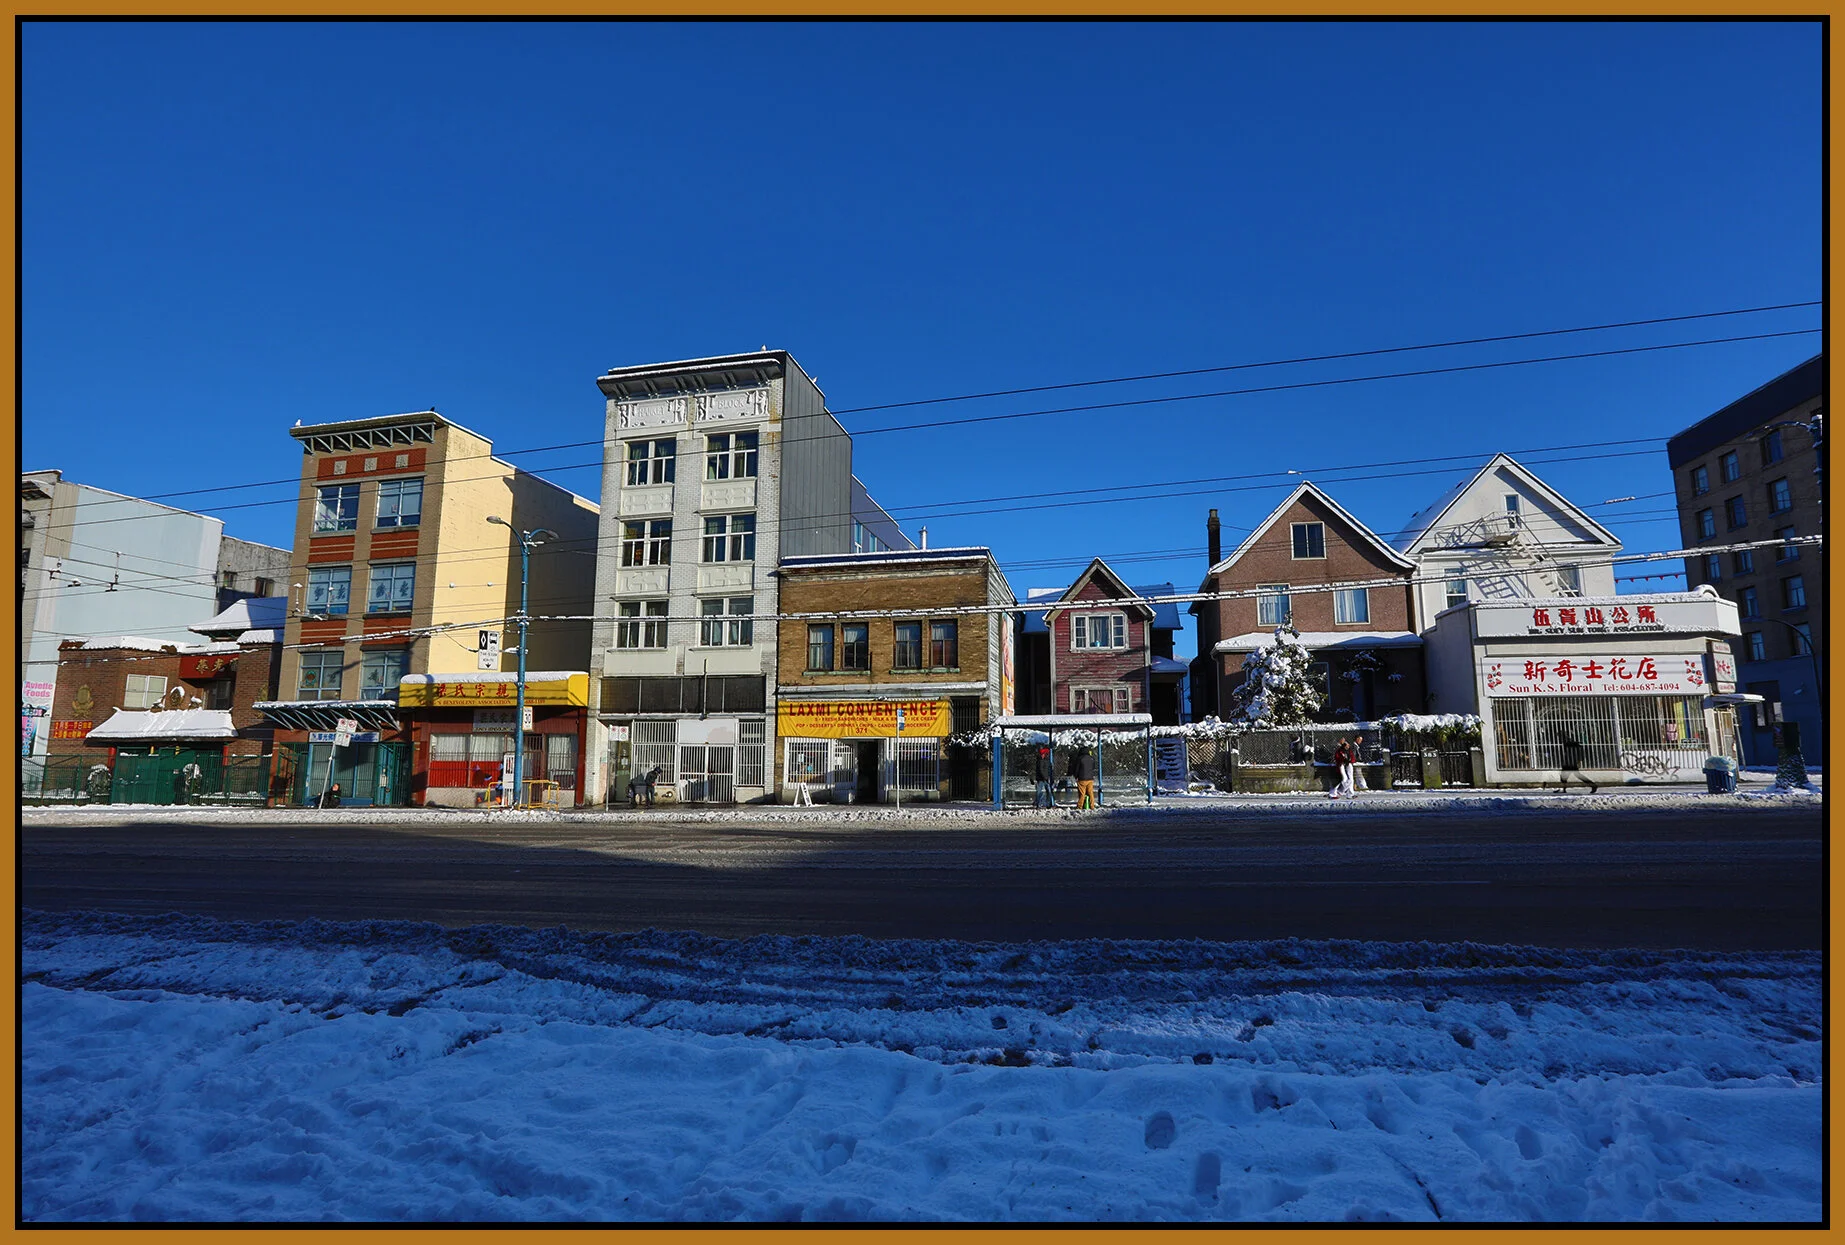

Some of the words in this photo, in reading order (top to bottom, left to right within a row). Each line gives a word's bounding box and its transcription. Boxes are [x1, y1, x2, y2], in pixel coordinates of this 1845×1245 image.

[1523, 656, 1658, 683] 新奇士花店
[1508, 683, 1530, 693] Sun
[1560, 682, 1593, 693] Floral
[789, 703, 830, 717] LAXMI
[837, 701, 937, 717] CONVENIENCE
